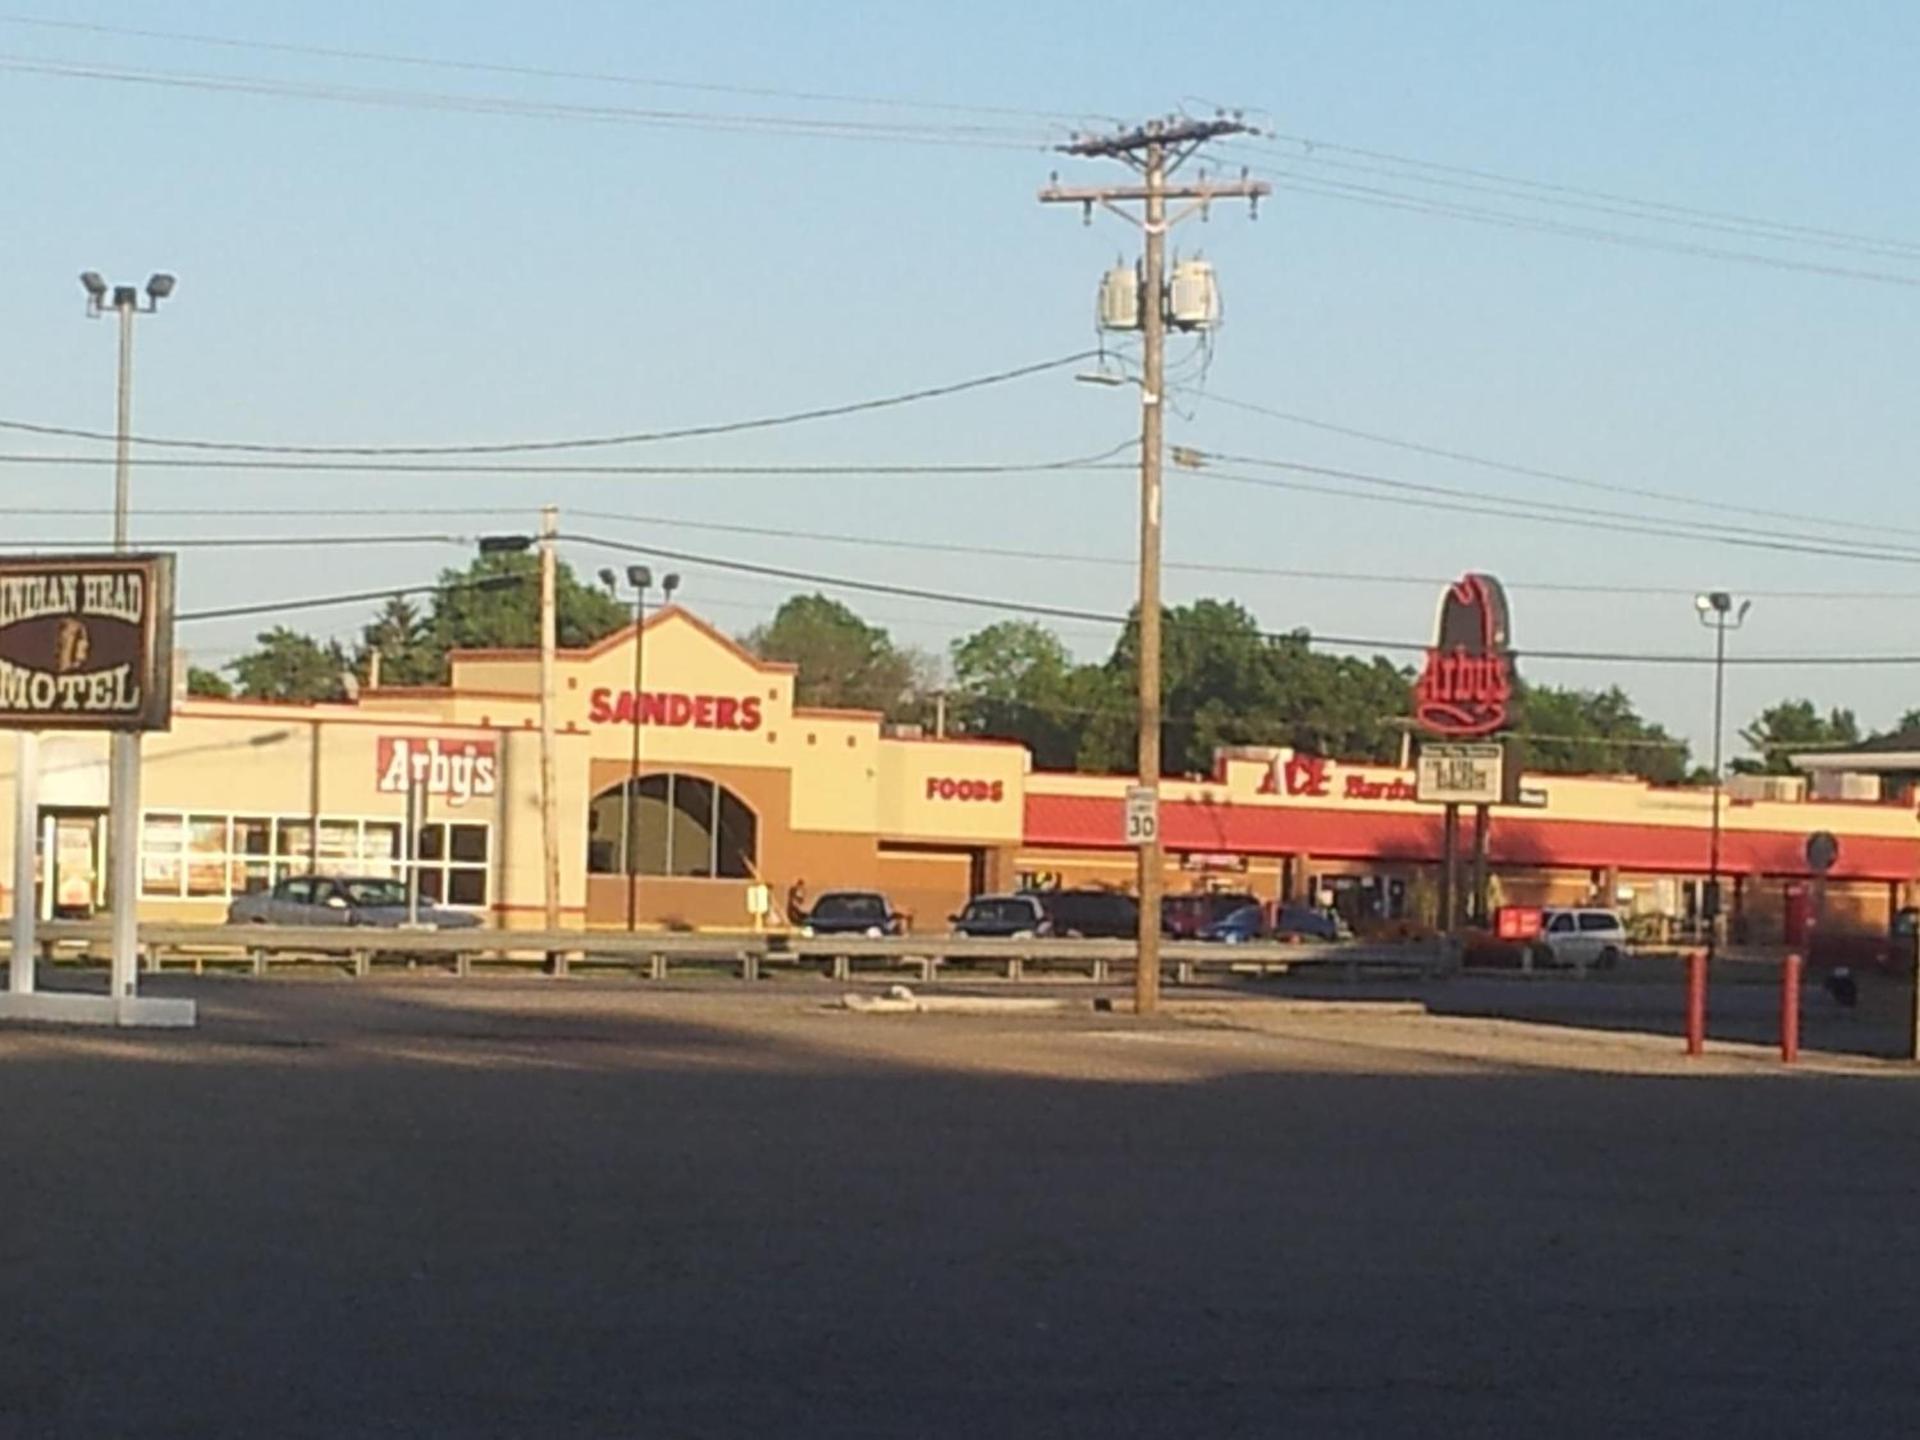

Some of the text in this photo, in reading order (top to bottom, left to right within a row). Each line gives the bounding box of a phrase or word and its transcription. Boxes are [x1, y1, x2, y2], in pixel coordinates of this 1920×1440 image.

[82, 573, 142, 623] HEAD
[0, 659, 140, 710] MOTEL
[588, 687, 762, 731] SANDERS
[926, 777, 1003, 803] FOODS
[1256, 752, 1331, 796] ACE
[1129, 814, 1155, 837] 30
